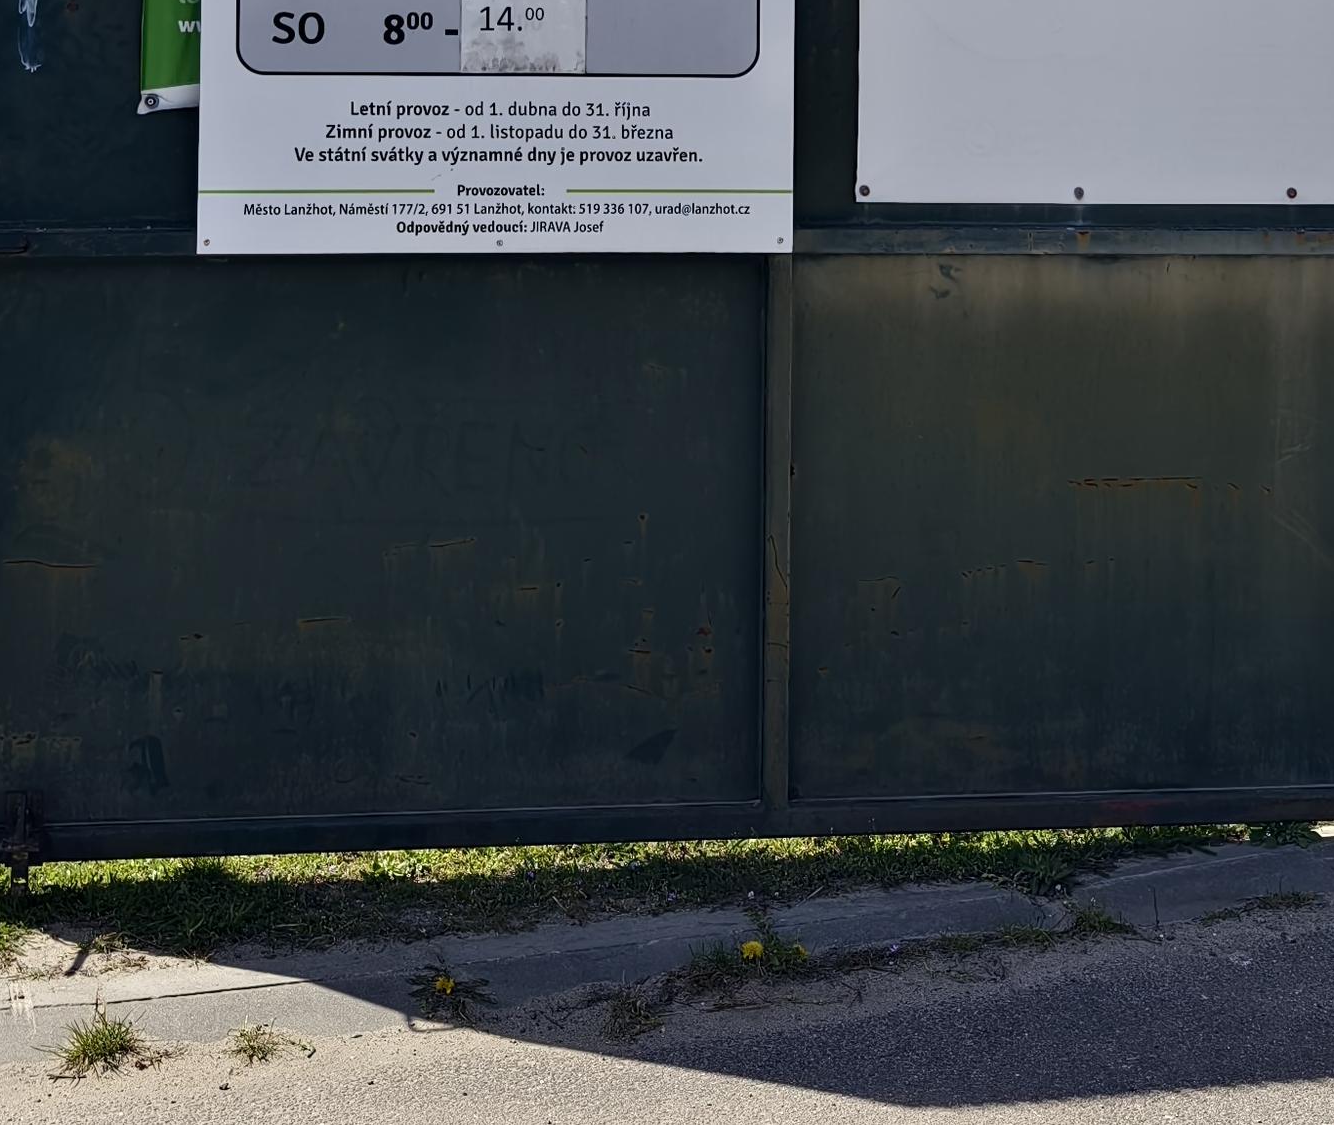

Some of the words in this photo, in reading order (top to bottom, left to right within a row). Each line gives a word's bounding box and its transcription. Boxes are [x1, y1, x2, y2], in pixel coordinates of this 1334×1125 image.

[271, 11, 325, 45] SO
[350, 100, 392, 116] Letní
[396, 104, 450, 120] provoz
[464, 100, 484, 116] od
[489, 102, 503, 116] 1.
[508, 101, 557, 117] dubna
[561, 101, 581, 117] do
[585, 102, 610, 117] 31.
[614, 101, 651, 121] října
[325, 123, 374, 139] Zimní
[378, 127, 432, 143] provoz
[446, 123, 466, 139] od
[471, 124, 485, 139] 1.
[490, 123, 564, 143] listopadu
[568, 124, 588, 140] do
[592, 125, 616, 140] 31.
[621, 124, 674, 140] března
[294, 147, 315, 162] Ve
[318, 146, 367, 162] státní
[370, 146, 424, 166] svátky
[428, 150, 438, 162] a
[441, 146, 523, 166] významné
[527, 146, 557, 166] dny
[560, 147, 575, 166] je
[579, 150, 632, 166] provoz
[636, 146, 703, 163] uzavřen.
[457, 183, 545, 197] Provozovatel:
[243, 203, 281, 216] Město
[284, 202, 336, 218] Lanžhot,
[339, 202, 389, 216] Náměstí
[392, 202, 429, 217] 177/2,
[431, 203, 452, 215] 691
[456, 203, 470, 215] 51
[474, 202, 525, 217] Lanžhot,
[527, 202, 576, 216] kontakt:
[578, 203, 601, 215] 519
[602, 203, 625, 215] 336
[628, 203, 652, 217] 107,
[654, 202, 751, 217] urad@lanzhot.cz
[396, 220, 470, 236] Odpovědný
[472, 220, 528, 233] vedoucí:
[530, 220, 571, 233] JIRAVA
[573, 220, 604, 233] Josef
